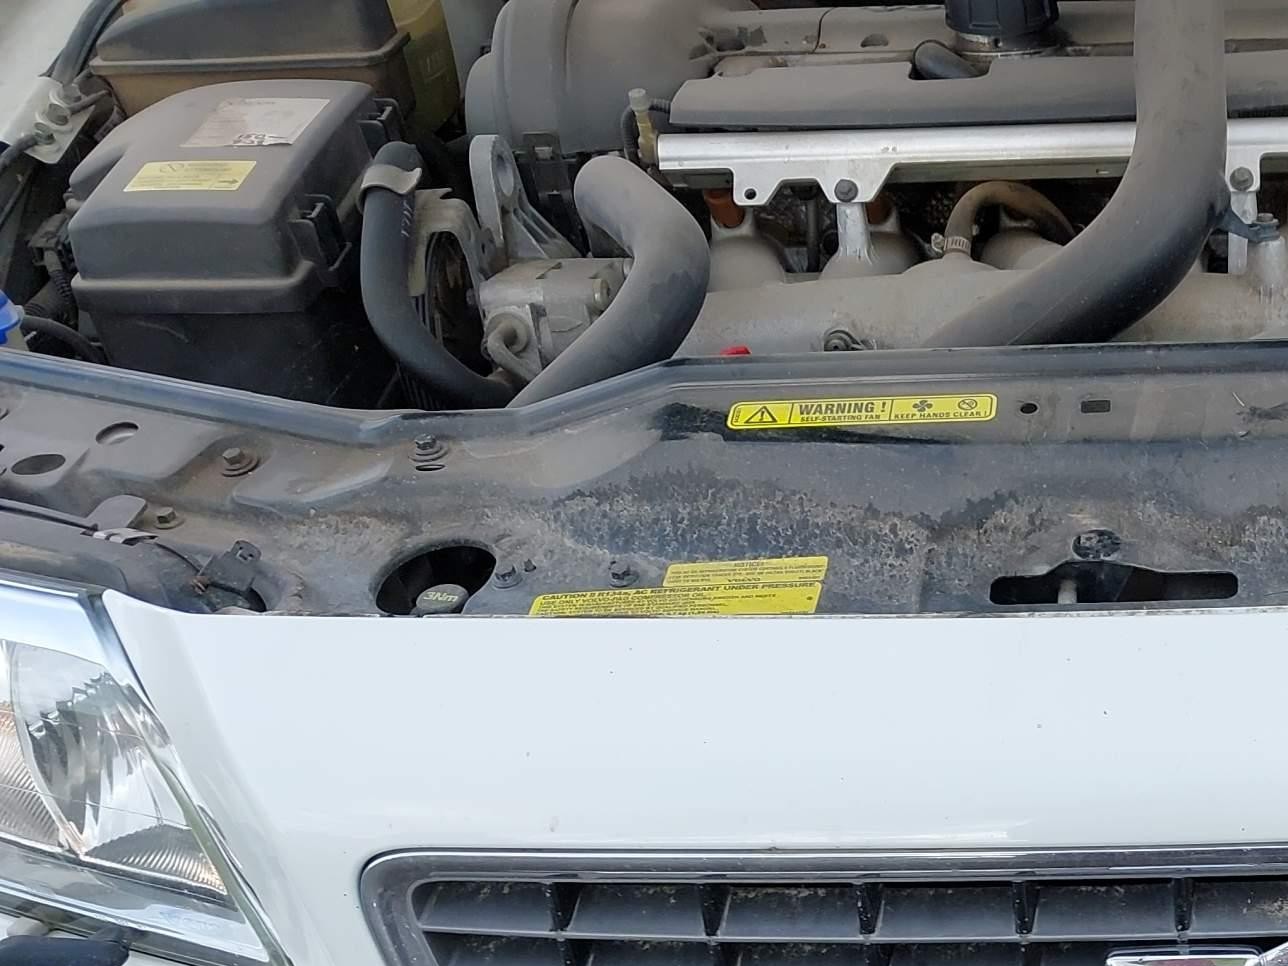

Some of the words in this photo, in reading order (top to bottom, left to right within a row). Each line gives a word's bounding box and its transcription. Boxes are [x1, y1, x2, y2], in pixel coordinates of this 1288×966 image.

[799, 401, 875, 416] WARNING
[919, 411, 951, 419] HANDS
[952, 410, 982, 418] CLEAR
[800, 414, 863, 422] SELF-STARTING
[542, 592, 587, 601] CAUTION
[650, 584, 722, 594] REFRIGERANT
[723, 582, 760, 591] UNDER
[761, 581, 817, 589] PRESSURE
